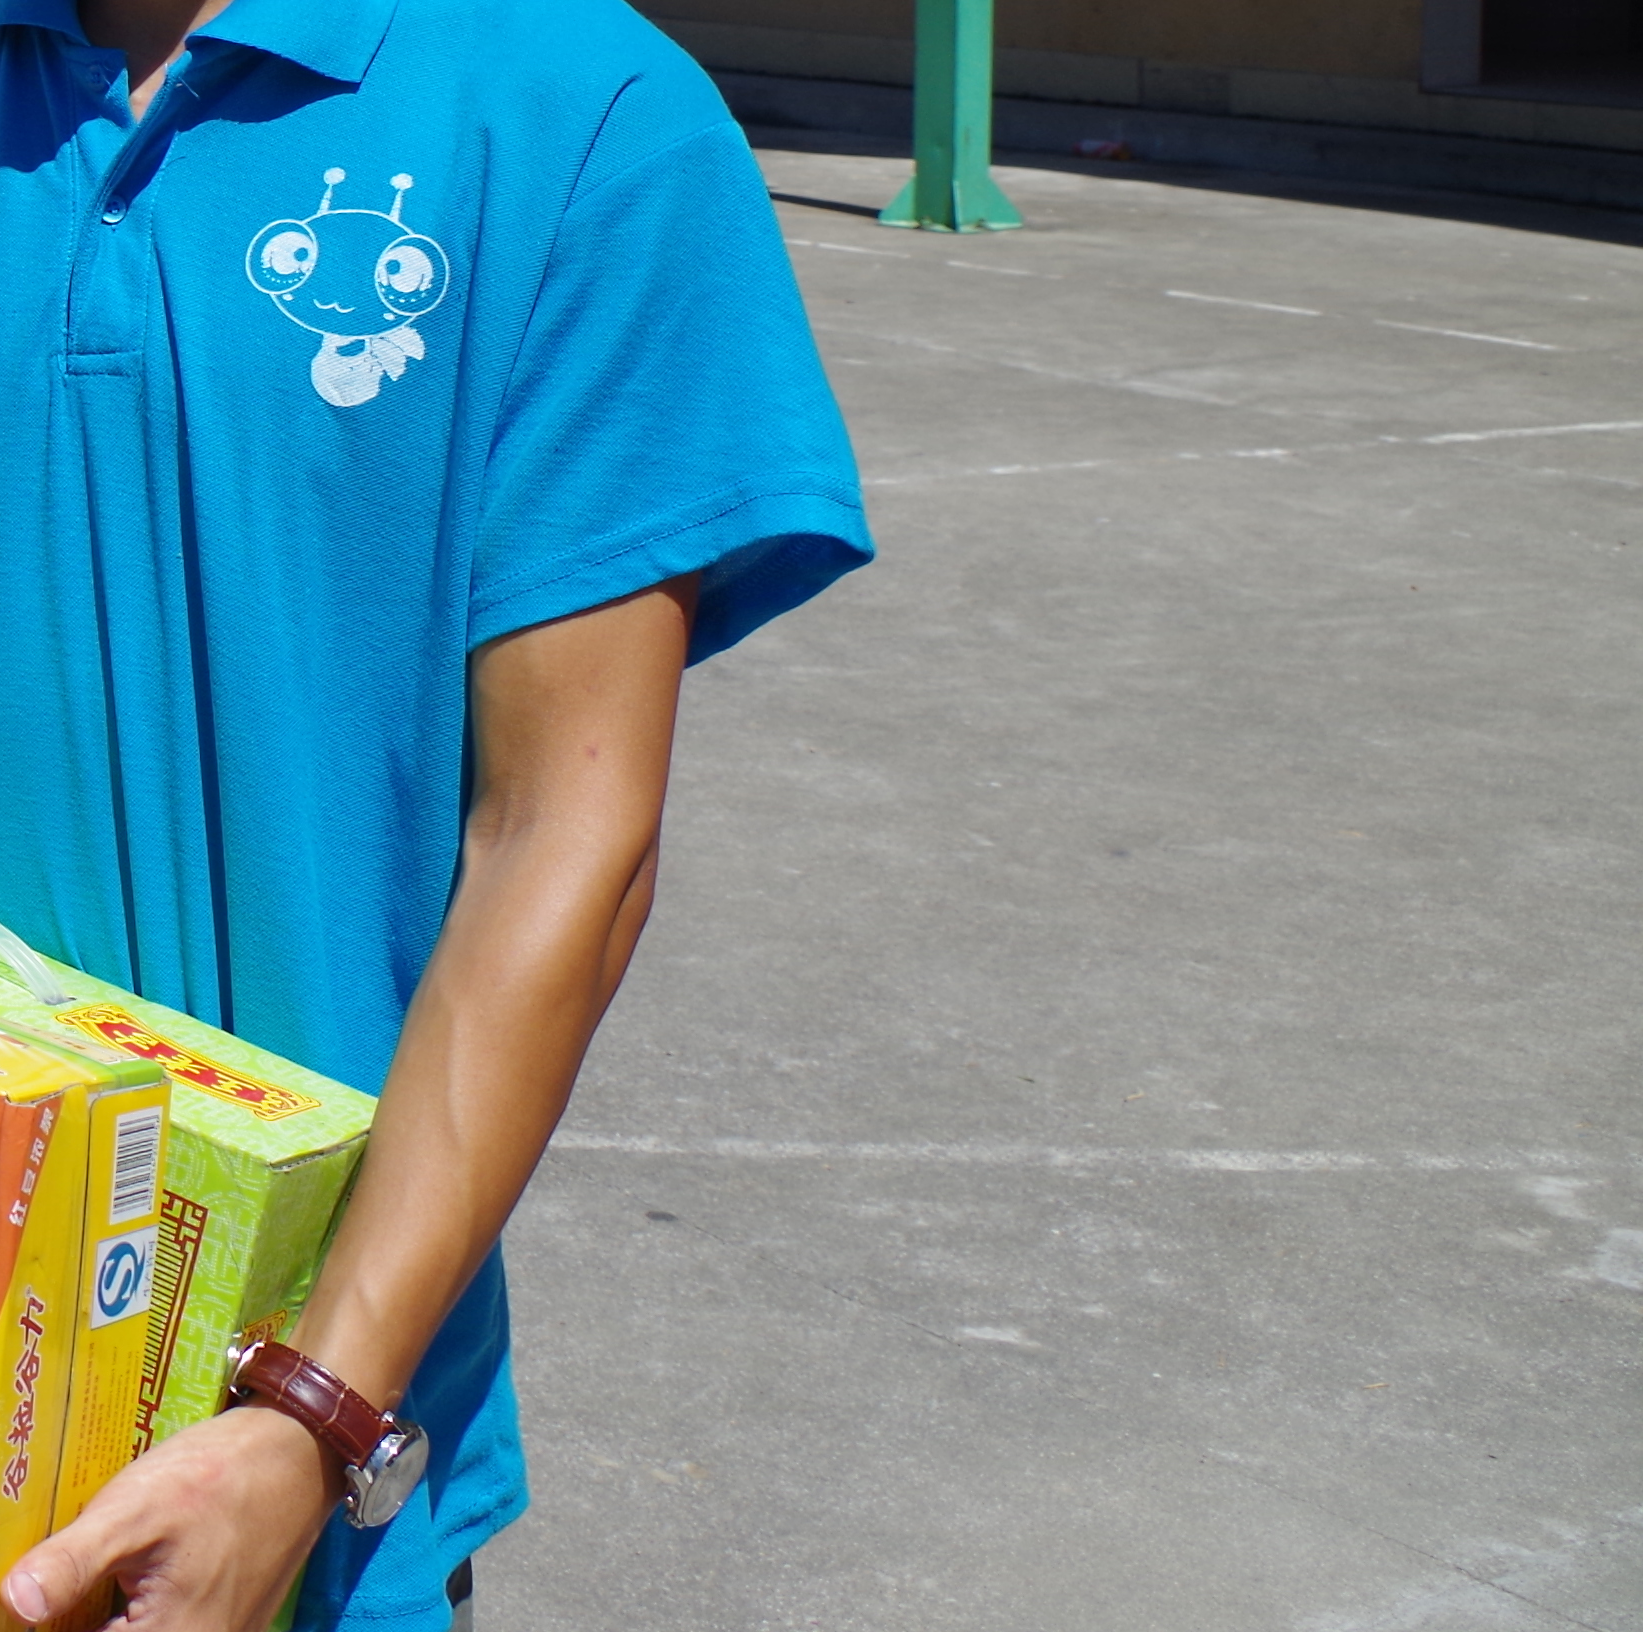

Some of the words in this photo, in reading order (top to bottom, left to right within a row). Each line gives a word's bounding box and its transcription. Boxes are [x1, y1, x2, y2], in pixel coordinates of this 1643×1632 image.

[9, 1106, 55, 1227] 红豆浓浆
[2, 1296, 45, 1502] 谷粒谷力
